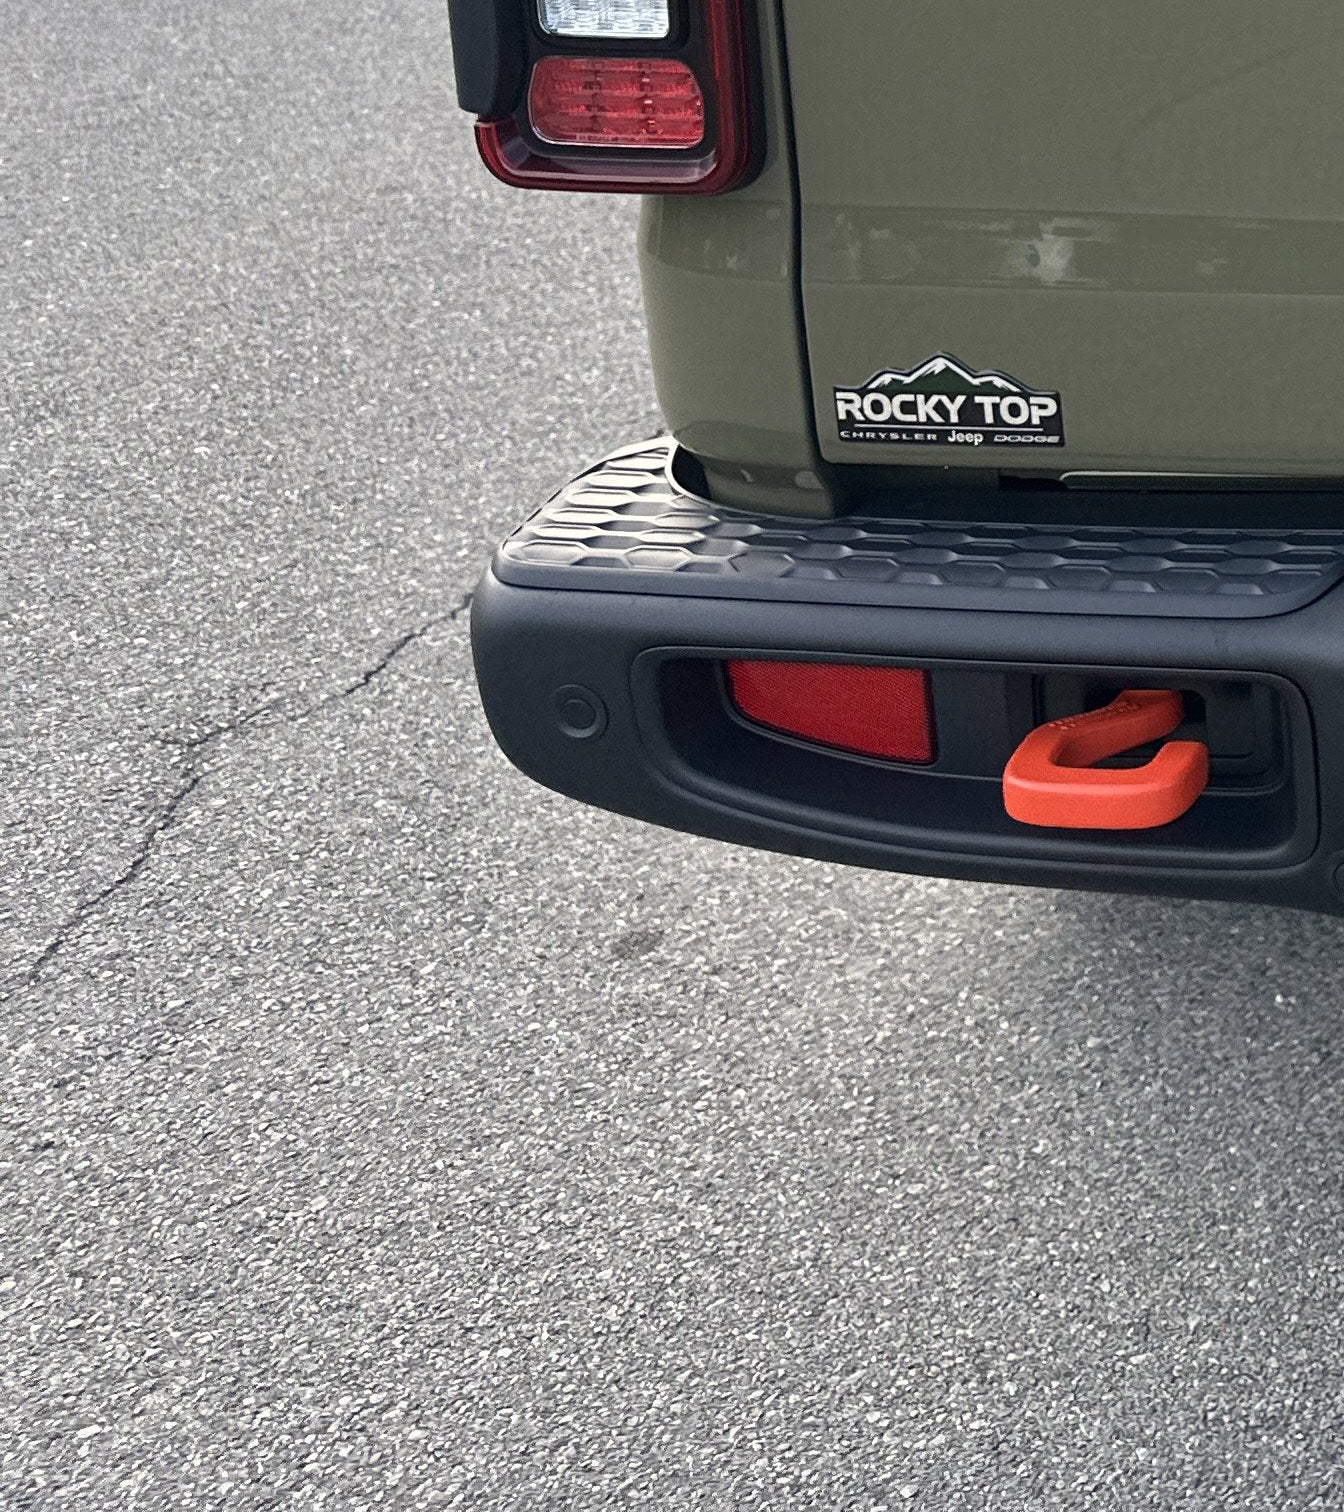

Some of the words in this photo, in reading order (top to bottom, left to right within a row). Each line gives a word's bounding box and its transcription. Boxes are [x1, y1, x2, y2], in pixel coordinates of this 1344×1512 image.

[835, 391, 967, 424] ROCKY
[973, 395, 1058, 426] TOP
[839, 430, 938, 442] CHRYSLER
[947, 429, 984, 446] Jeep
[993, 434, 1061, 444] DODGE
